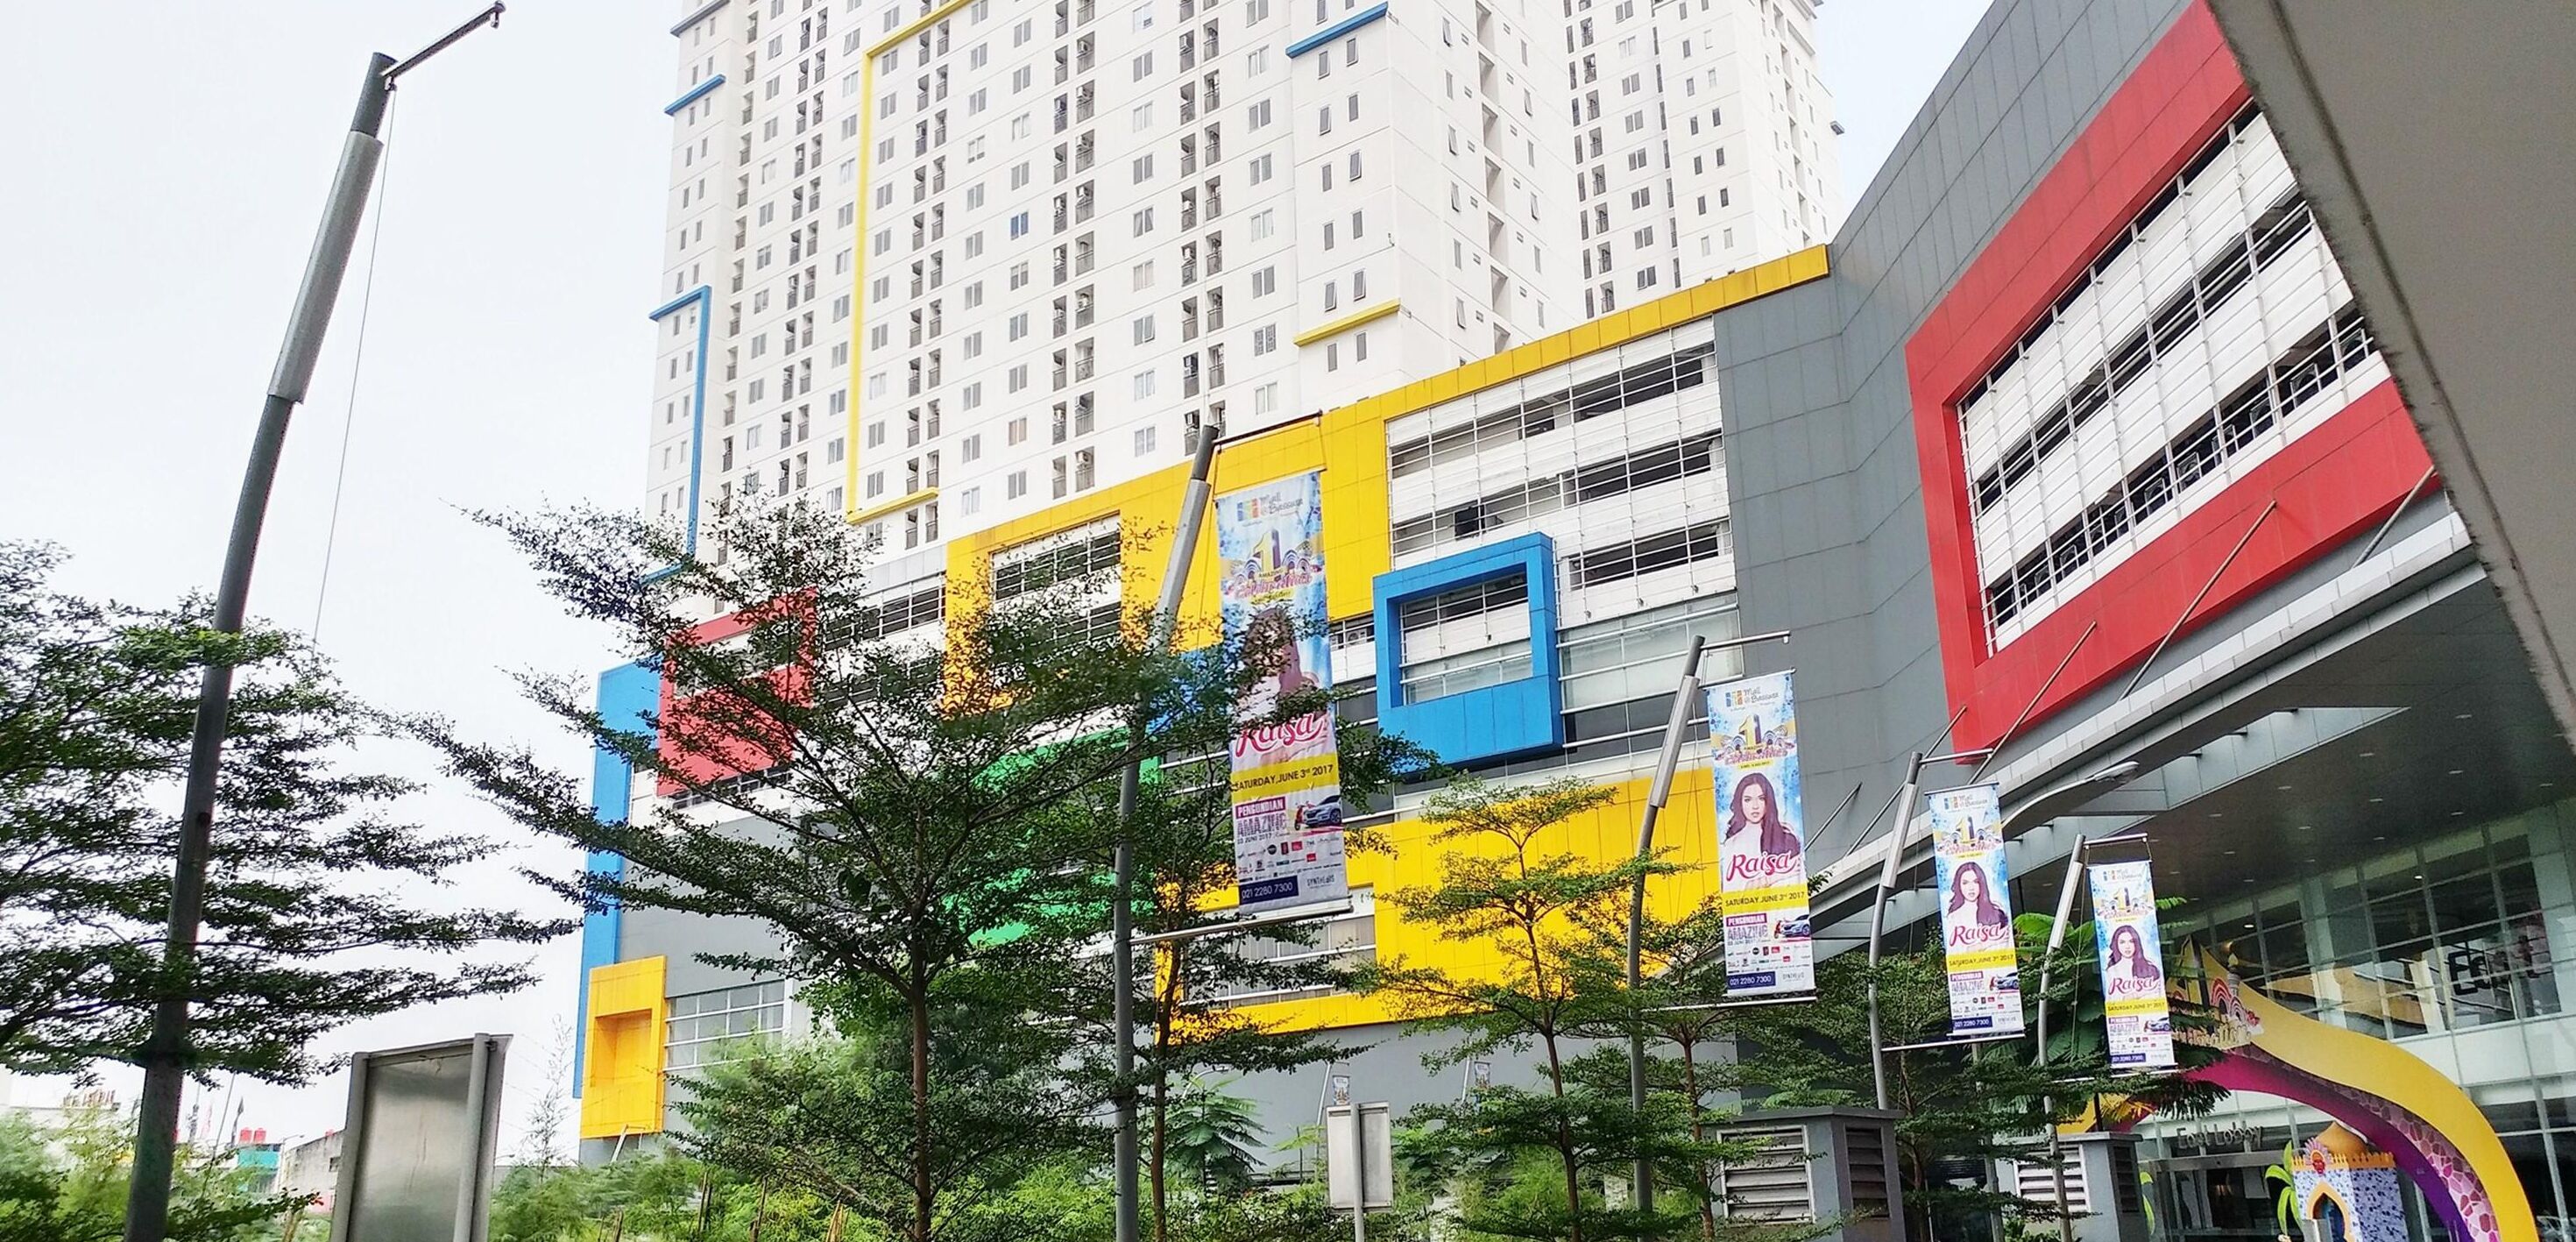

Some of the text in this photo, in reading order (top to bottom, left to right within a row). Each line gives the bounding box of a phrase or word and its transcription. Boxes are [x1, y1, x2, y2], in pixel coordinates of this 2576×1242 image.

[1277, 770, 1299, 784] JUNE
[1313, 764, 1334, 776] 2017
[1727, 850, 1796, 882] Raisa
[1242, 889, 1253, 899] 021
[1274, 882, 1293, 893] 7300
[1950, 923, 2006, 947] Raisa
[1756, 975, 1772, 983] 7300
[2108, 976, 2159, 996] Raisa
[2213, 1120, 2261, 1149] Lobby
